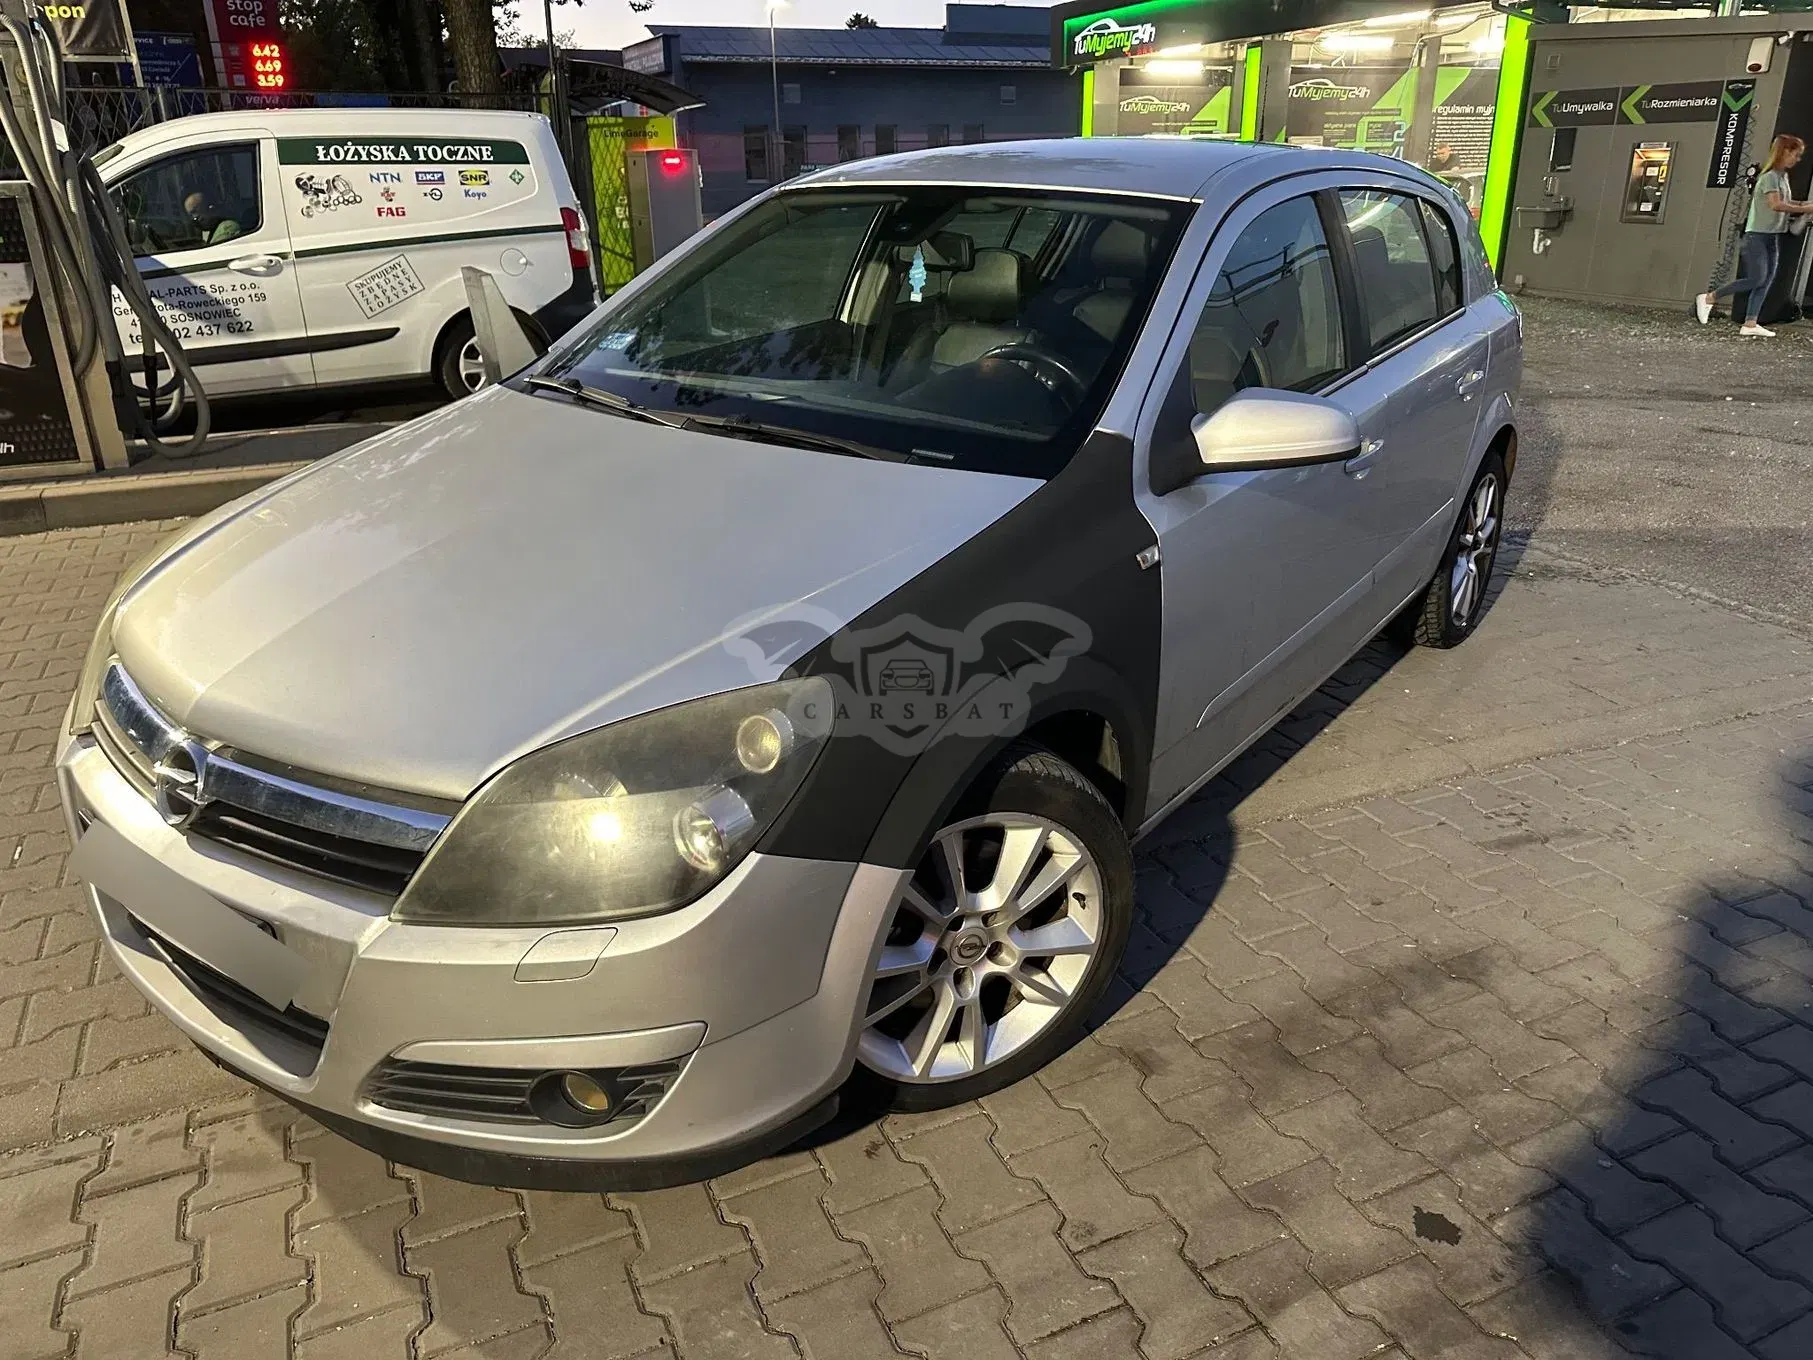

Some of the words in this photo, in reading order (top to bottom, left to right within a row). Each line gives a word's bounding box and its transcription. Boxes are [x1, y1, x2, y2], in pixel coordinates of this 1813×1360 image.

[44, 5, 85, 21] pon
[226, 0, 263, 14] stop
[229, 14, 265, 27] cafe
[1074, 23, 1156, 56] TuMyjemy24h
[252, 44, 280, 57] 6.42
[255, 59, 282, 72] 6.69
[257, 74, 284, 87] 3.59
[245, 94, 280, 104] verva
[1288, 86, 1370, 101] TuMyjemy24h
[1120, 102, 1190, 114] TuMyjemy24h
[1552, 100, 1613, 115] TuUmywalka
[1641, 96, 1717, 109] TuRozmieniarka
[1432, 104, 1474, 116] regulamin
[1476, 104, 1495, 116] myjn
[603, 129, 659, 139] LimeGarage
[315, 141, 411, 162] ŁOŻYSKA
[414, 145, 494, 161] TOCZNE
[1716, 113, 1738, 185] KOMPRESOR
[369, 172, 402, 183] NTN
[416, 173, 441, 181] SKF
[460, 173, 486, 182] SNR
[463, 188, 487, 200] Koyo
[377, 206, 406, 217] FAG
[354, 261, 403, 290] SKUPUJEMY
[210, 284, 228, 295] Sp.
[240, 282, 260, 291] o.o.
[155, 296, 245, 312] ota-Roweckiego
[249, 293, 267, 303] 159
[170, 307, 241, 324] SOSNOWIEC
[129, 333, 143, 345] te
[174, 327, 191, 339] 02
[196, 324, 221, 337] 437
[227, 320, 254, 334] 622
